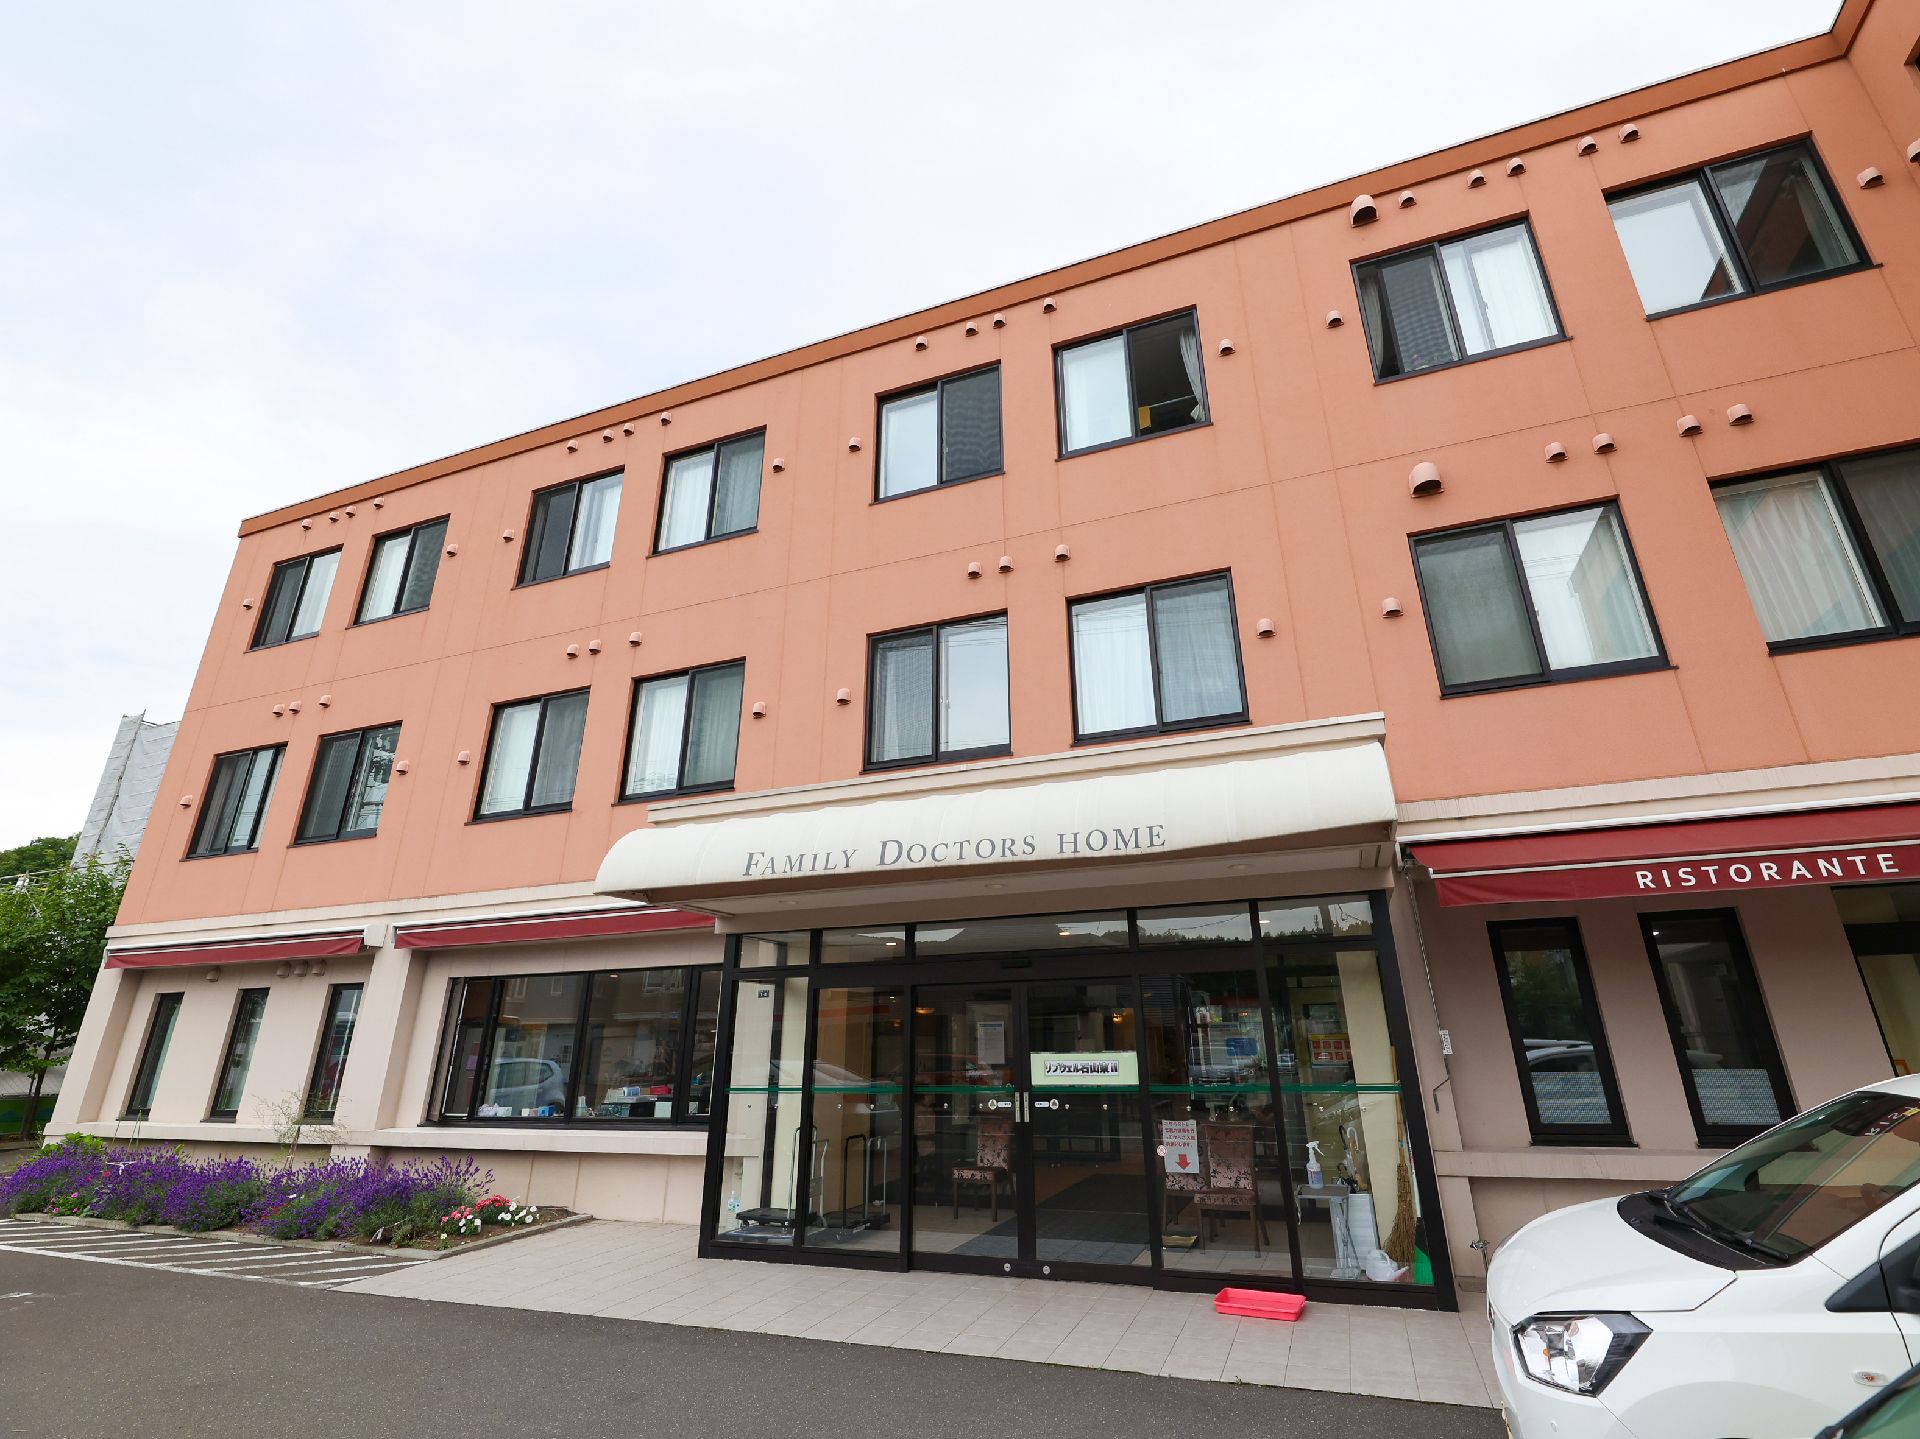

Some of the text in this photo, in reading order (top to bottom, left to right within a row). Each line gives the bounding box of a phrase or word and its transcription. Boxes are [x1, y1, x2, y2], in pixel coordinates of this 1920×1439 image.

[742, 824, 1167, 877] FAMILY DOCTORS HOME
[1636, 853, 1899, 889] RISTORANTE
